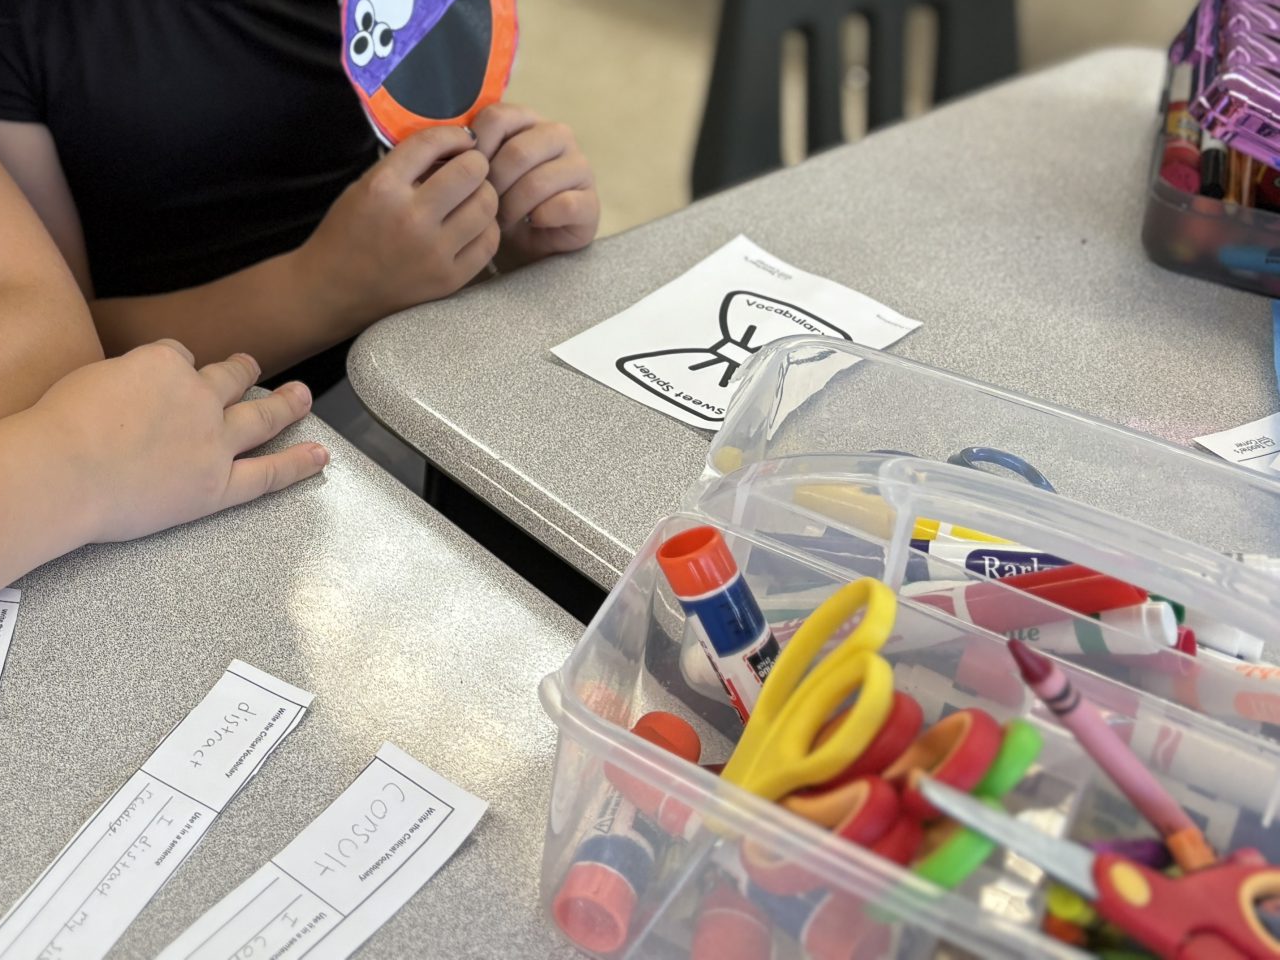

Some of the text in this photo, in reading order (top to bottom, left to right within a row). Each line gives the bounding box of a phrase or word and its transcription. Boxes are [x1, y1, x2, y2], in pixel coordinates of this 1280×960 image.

[633, 362, 675, 393] Spider
[190, 702, 257, 768] distract
[224, 707, 286, 778] Write the Critical Vocabulary
[157, 814, 174, 827] I
[190, 811, 202, 825] Use
[155, 839, 179, 867] sentence
[358, 806, 436, 882] Write the Critical Vocabulary
